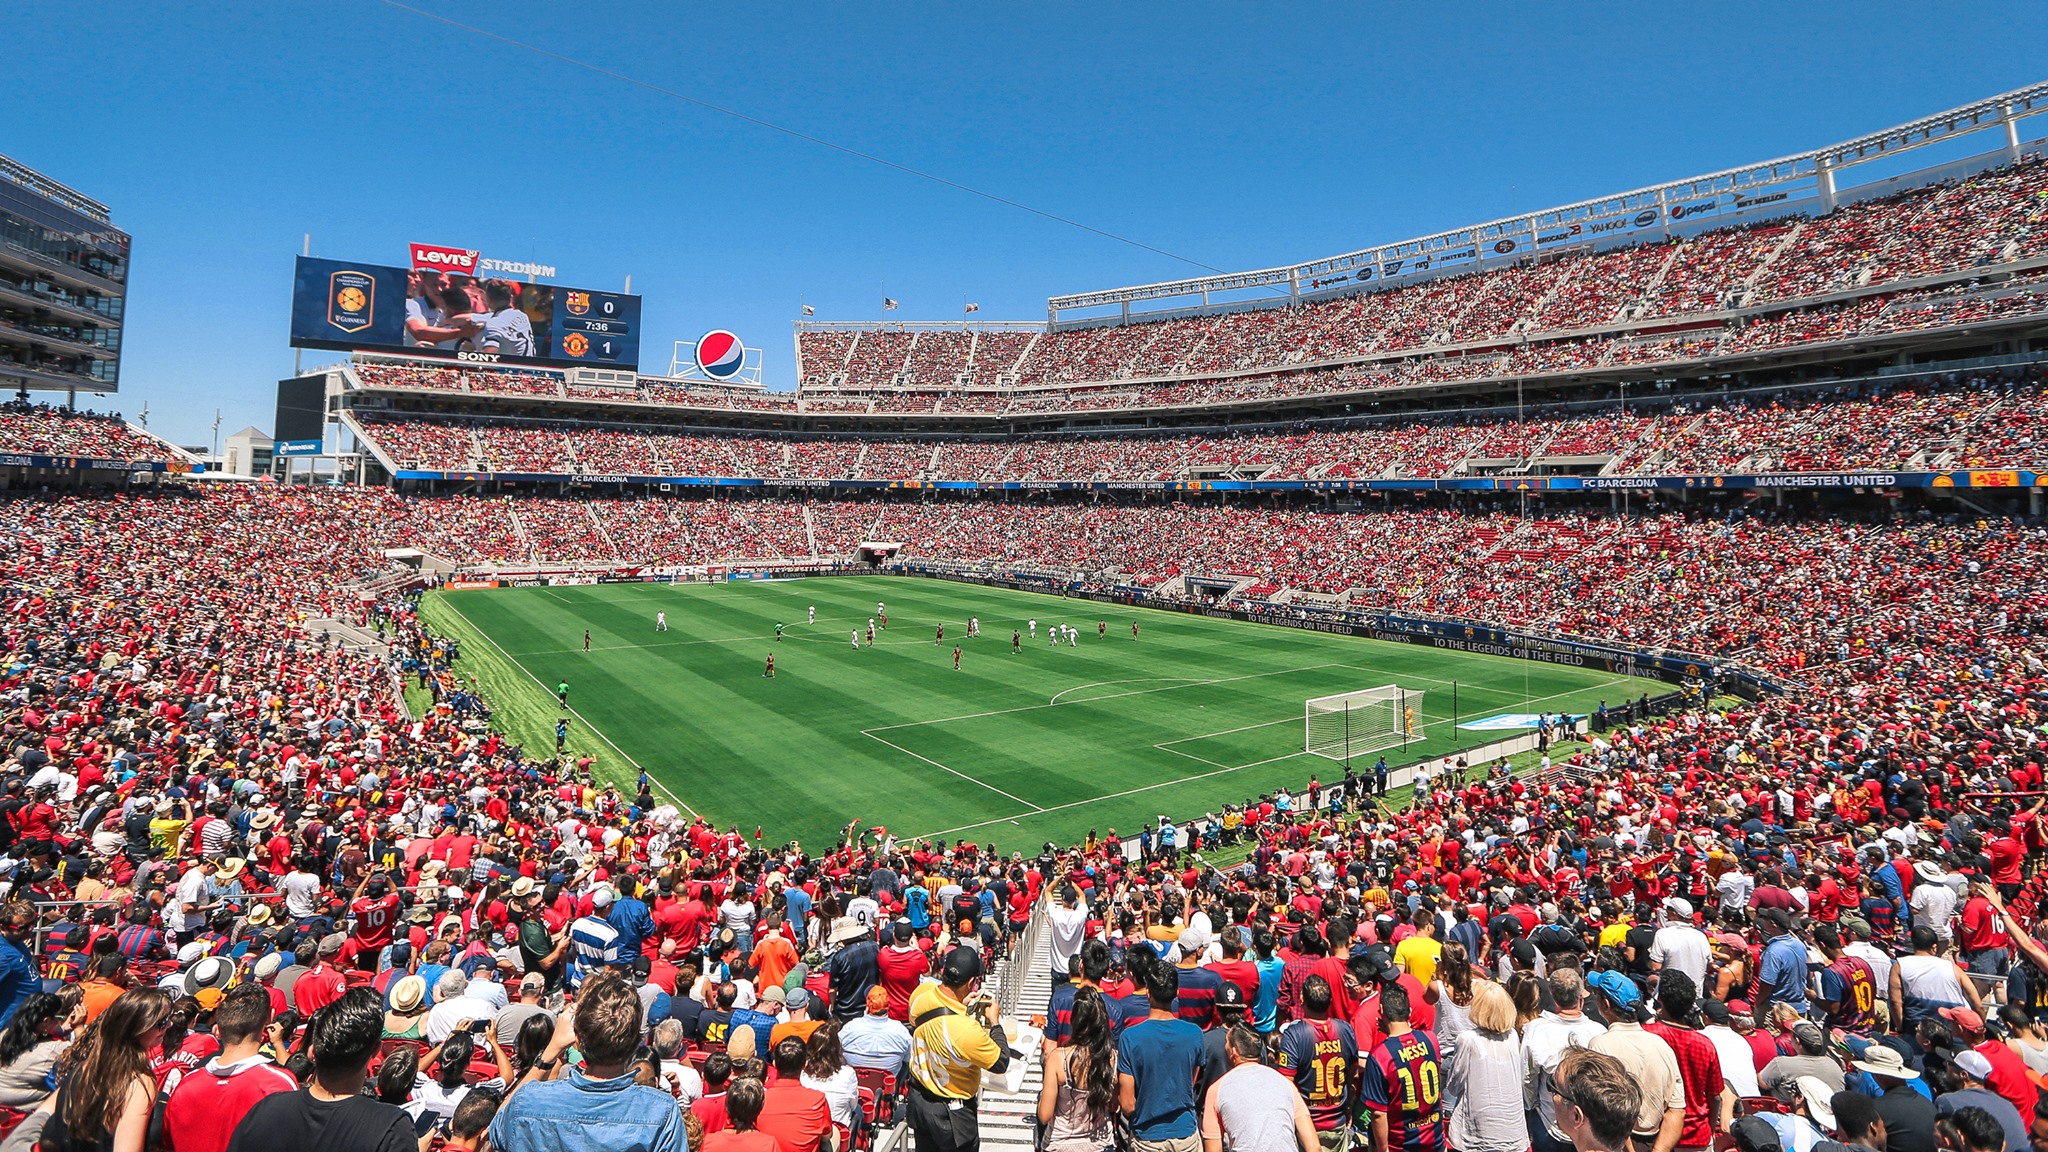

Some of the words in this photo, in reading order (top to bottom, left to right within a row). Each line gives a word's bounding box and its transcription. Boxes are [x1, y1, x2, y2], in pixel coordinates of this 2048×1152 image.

[1687, 202, 1716, 216] pepsi
[1590, 219, 1626, 234] YAHOO!
[1538, 233, 1568, 244] BROCADE
[1441, 253, 1467, 261] UNITED
[481, 258, 556, 278] STADIUM
[1385, 264, 1399, 274] SAP
[1415, 261, 1429, 269] nrg
[603, 302, 614, 314] 0
[340, 315, 367, 324] GUINNESS
[585, 321, 608, 332] 7:36
[602, 341, 611, 354] 1
[457, 351, 500, 363] SONY
[92, 460, 130, 469] MANCHESTER
[132, 461, 152, 470] UNITED
[583, 475, 628, 483] BARCELONA
[1582, 479, 1596, 488] FC
[1598, 479, 1658, 488] BARCELONA
[1755, 476, 1841, 487] MANCHESTER
[1843, 475, 1896, 486] UNITED
[1067, 590, 1080, 598] FIELD
[1135, 599, 1156, 607] SANTA
[1206, 609, 1232, 619] GUINNESS
[1247, 614, 1257, 622] TO
[1258, 615, 1271, 624] THE
[1271, 617, 1302, 628] LEGENDS
[1303, 621, 1315, 629] ON
[1316, 622, 1331, 632] THE
[1332, 624, 1352, 635] FIELD
[1375, 631, 1411, 644] GUINNESS
[1433, 637, 1445, 647] TO
[1447, 639, 1465, 650] THE
[1467, 641, 1511, 656] LEGENDS
[1513, 648, 1529, 659] ON
[1532, 650, 1552, 662] THE
[1554, 653, 1583, 666] FIELD
[1575, 647, 1619, 662] CHAMPIONS
[1615, 662, 1661, 679] GUINNESS
[652, 842, 662, 853] 22
[1378, 867, 1387, 878] 10
[367, 909, 386, 928] 10
[857, 911, 866, 926] 9
[1991, 913, 2004, 934] 16
[1853, 981, 1872, 1014] 10
[1315, 1039, 1342, 1056] MESSI
[1397, 1041, 1429, 1063] MESSI
[1280, 1055, 1287, 1065] 3
[1309, 1056, 1346, 1100] 10
[1397, 1060, 1439, 1110] 10
